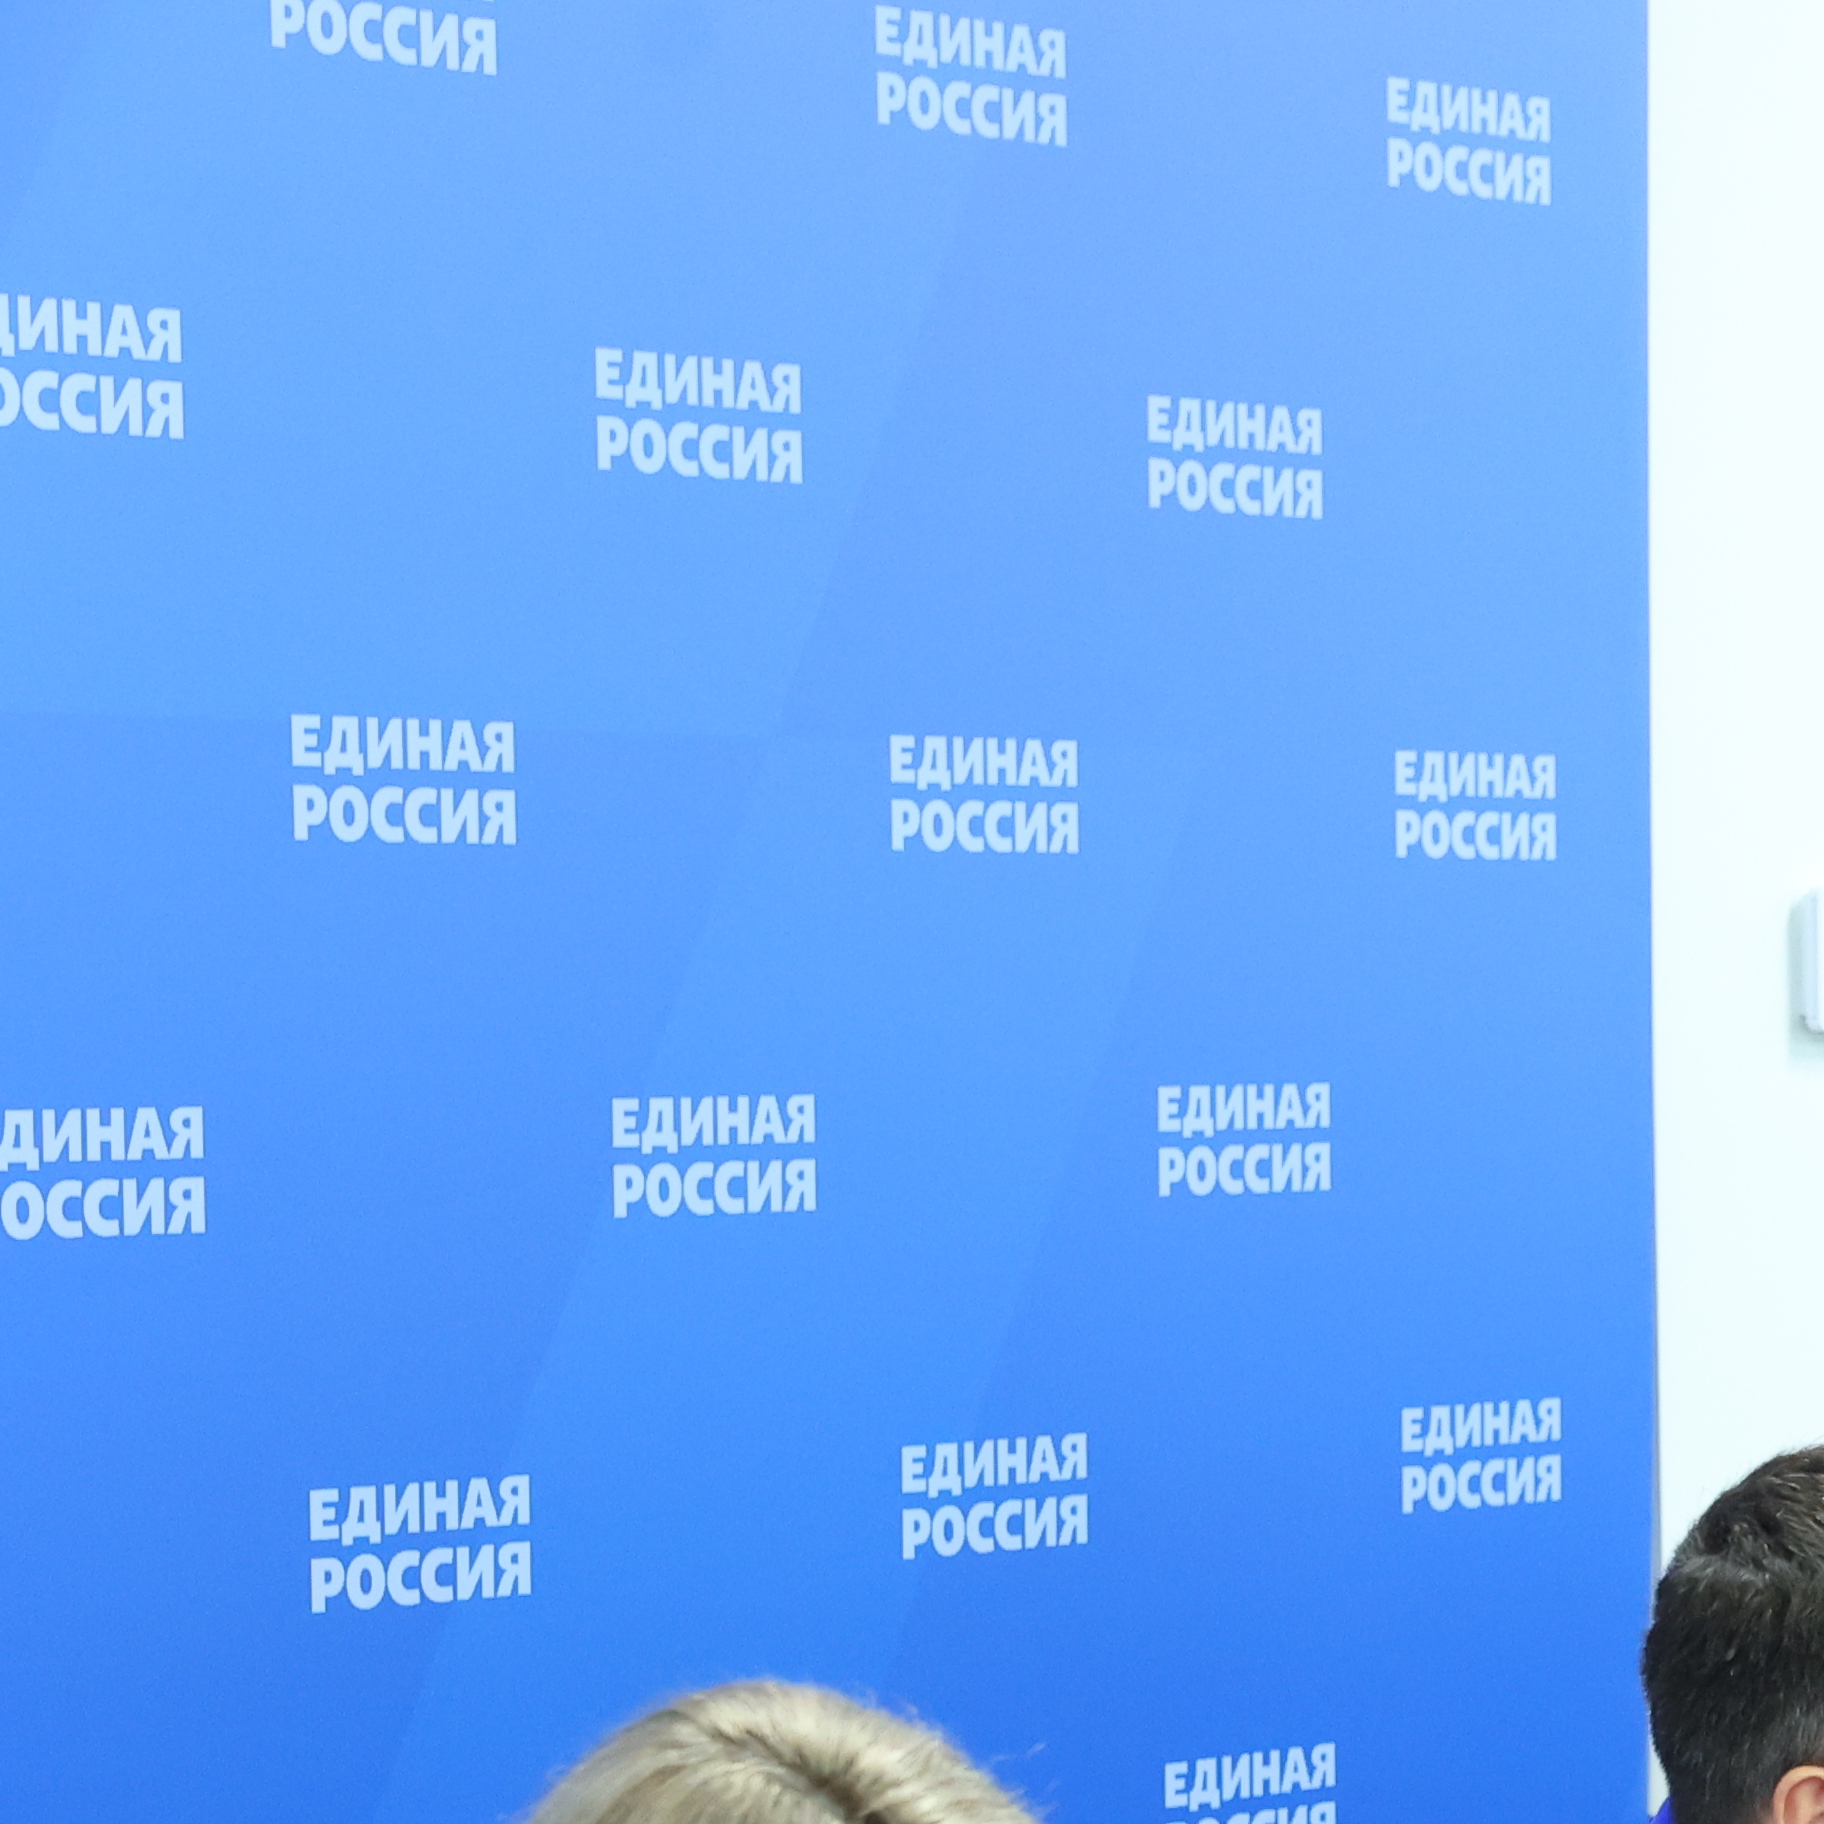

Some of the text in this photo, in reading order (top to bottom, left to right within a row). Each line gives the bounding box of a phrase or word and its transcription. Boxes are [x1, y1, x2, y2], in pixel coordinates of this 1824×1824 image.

[270, 0, 497, 75] РОССИЯ
[875, 5, 1066, 78] ЕДИНАЯ
[877, 72, 1067, 146] РОССИЯ
[1387, 77, 1550, 142] ЕДИНАЯ
[1388, 137, 1551, 205] РОССИЯ
[595, 347, 801, 414] ЕДИНАЯ
[597, 415, 803, 484] РОССИЯ
[1147, 395, 1322, 455] ЕДИНАЯ
[1148, 457, 1323, 519] РОССИЯ
[291, 714, 514, 776] ЕДИНАЯ
[890, 735, 1078, 791] ЕДИНАЯ
[1395, 750, 1556, 803] ЕДИНАЯ
[293, 784, 516, 845] РОССИЯ
[891, 798, 1079, 854] РОССИЯ
[1395, 809, 1556, 860] РОССИЯ
[0, 1106, 204, 1172] ДИНАЯ
[612, 1094, 815, 1154] ЕДИНАЯ
[1157, 1082, 1330, 1138] ЕДИНАЯ
[613, 1158, 816, 1218] РОССИЯ
[1158, 1142, 1331, 1197] РОССИЯ
[1, 1176, 206, 1240] ОССИЯ
[1401, 1397, 1561, 1457] ЕДИНАЯ
[901, 1432, 1088, 1498] ЕДИНАЯ
[1401, 1454, 1561, 1514] РОССИЯ
[310, 1474, 530, 1546] ЕДИНАЯ
[902, 1494, 1088, 1560] РОССИЯ
[311, 1541, 531, 1613] РОССИЯ
[1164, 1742, 1336, 1812] ЕДИНАЯ
